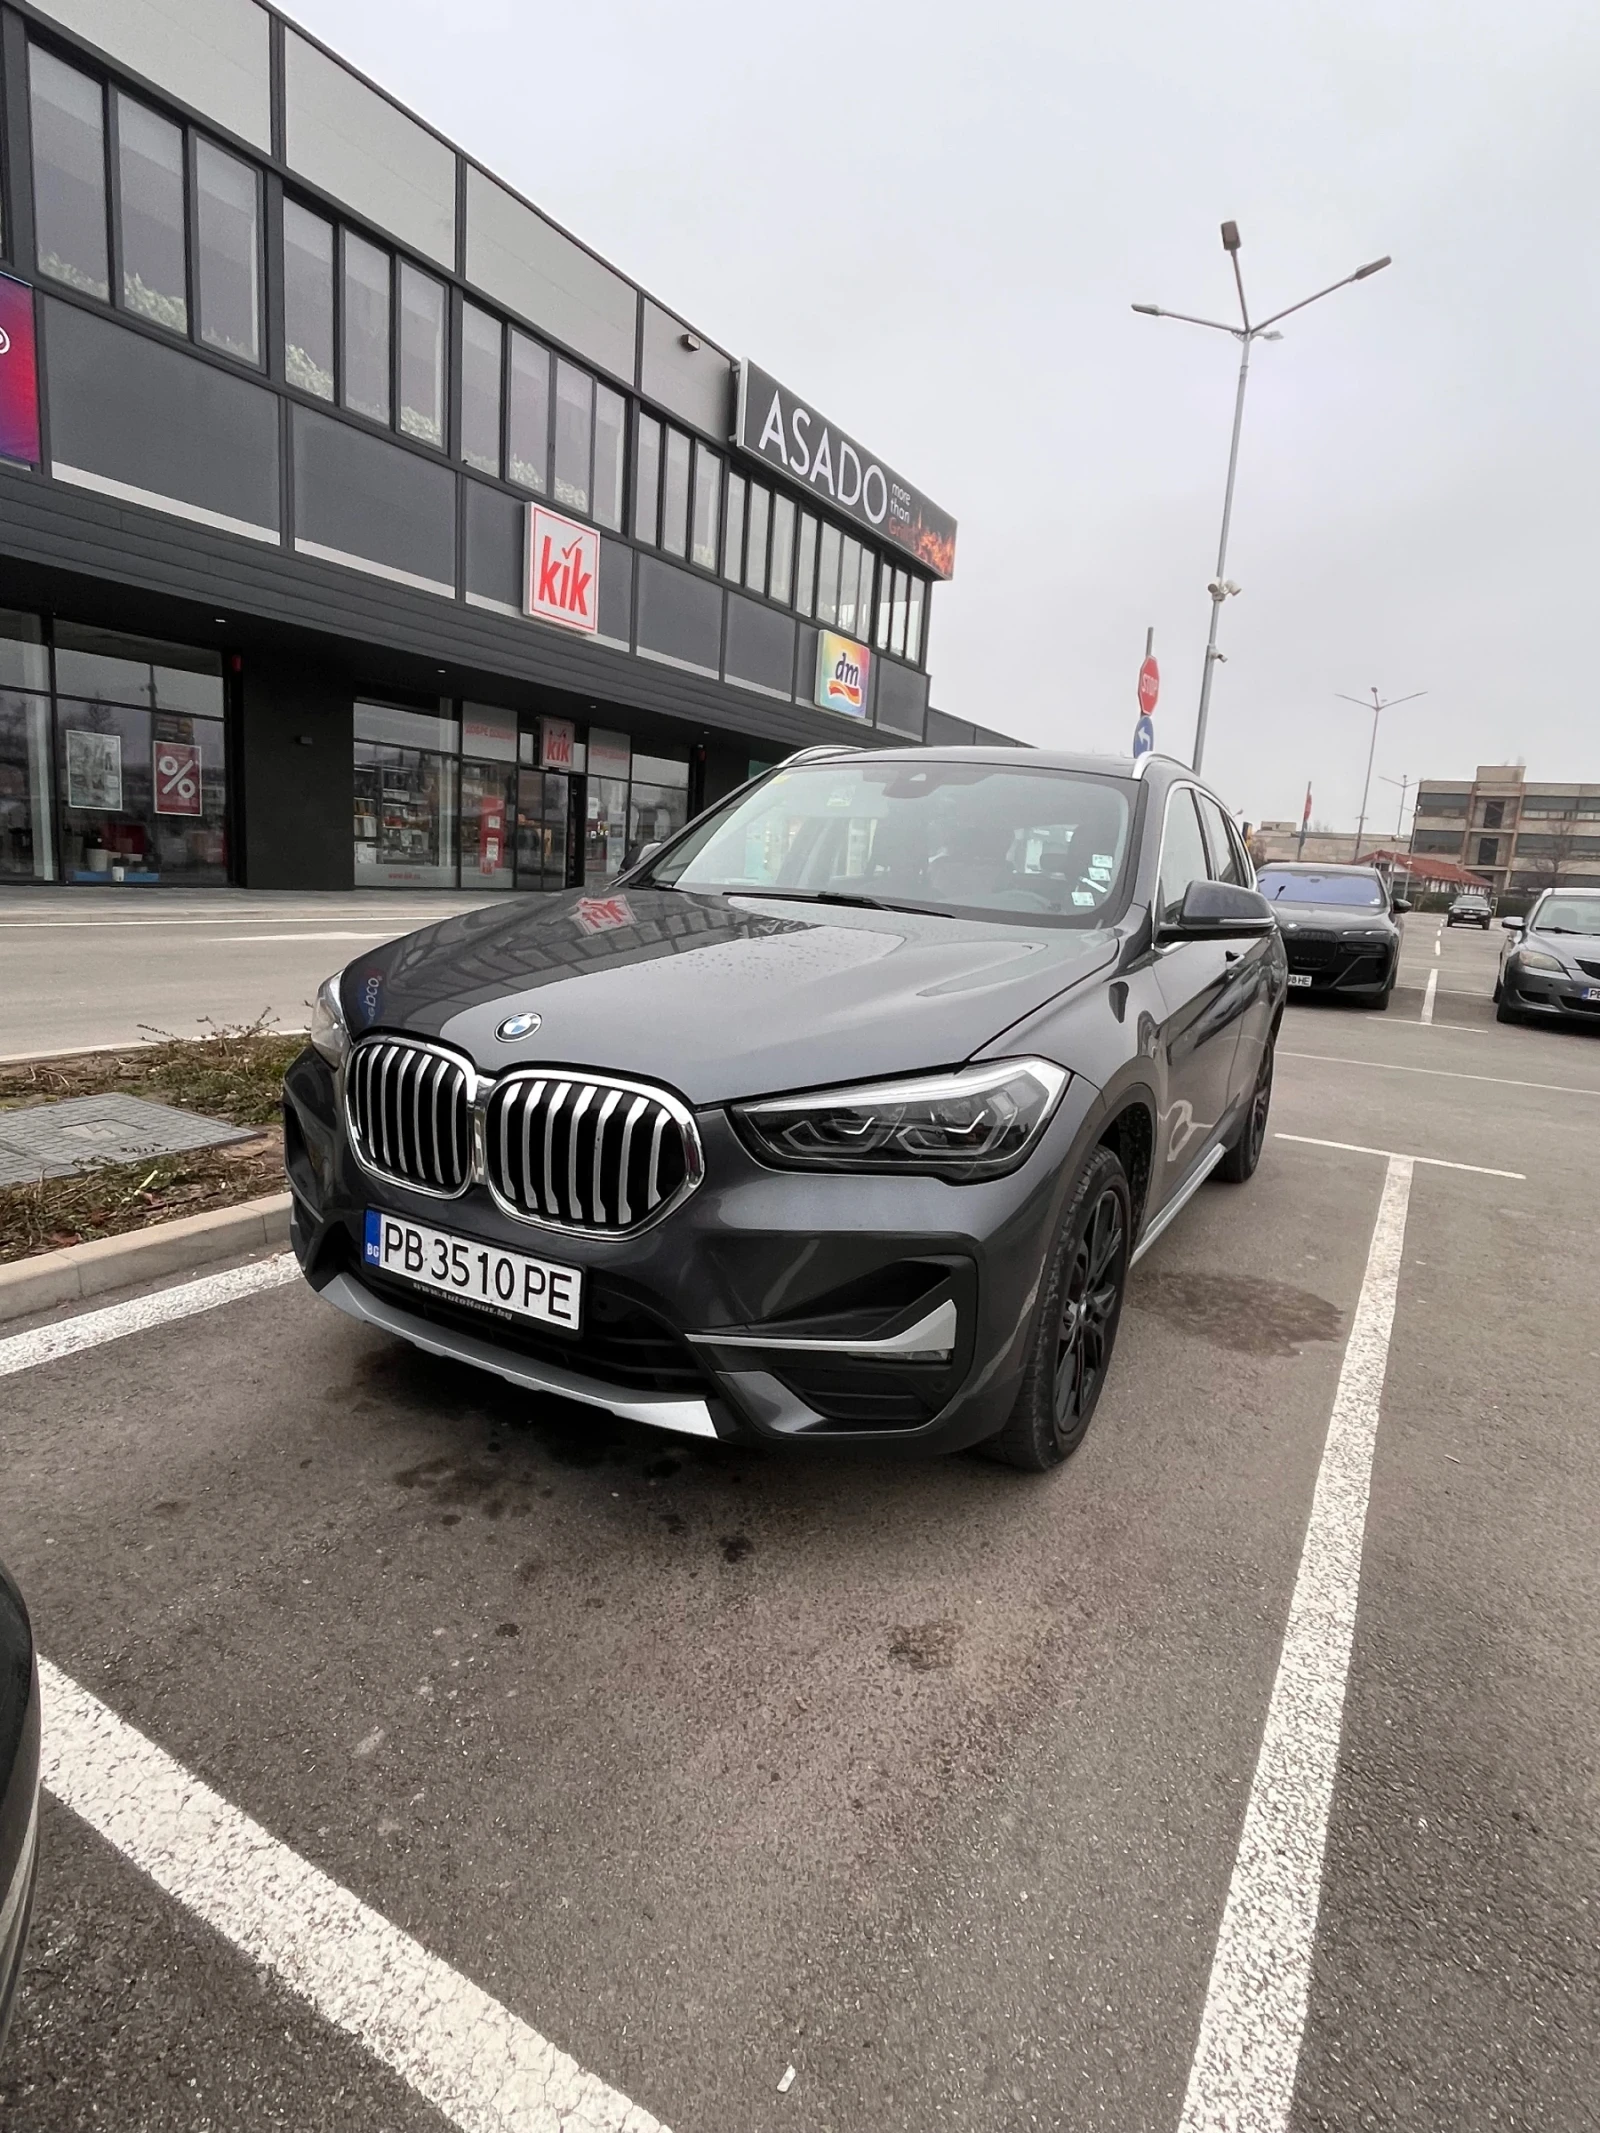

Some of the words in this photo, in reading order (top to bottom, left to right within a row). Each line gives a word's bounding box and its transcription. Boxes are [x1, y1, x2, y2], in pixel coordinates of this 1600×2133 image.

[758, 389, 888, 524] ASADO
[890, 497, 910, 524] than
[892, 483, 911, 506] more
[538, 535, 592, 616] kik
[835, 652, 859, 687] dm
[546, 729, 570, 763] kik
[367, 1244, 379, 1258] BG
[385, 1221, 424, 1273] PB
[431, 1239, 515, 1300] 3510
[523, 1264, 572, 1321] PE
